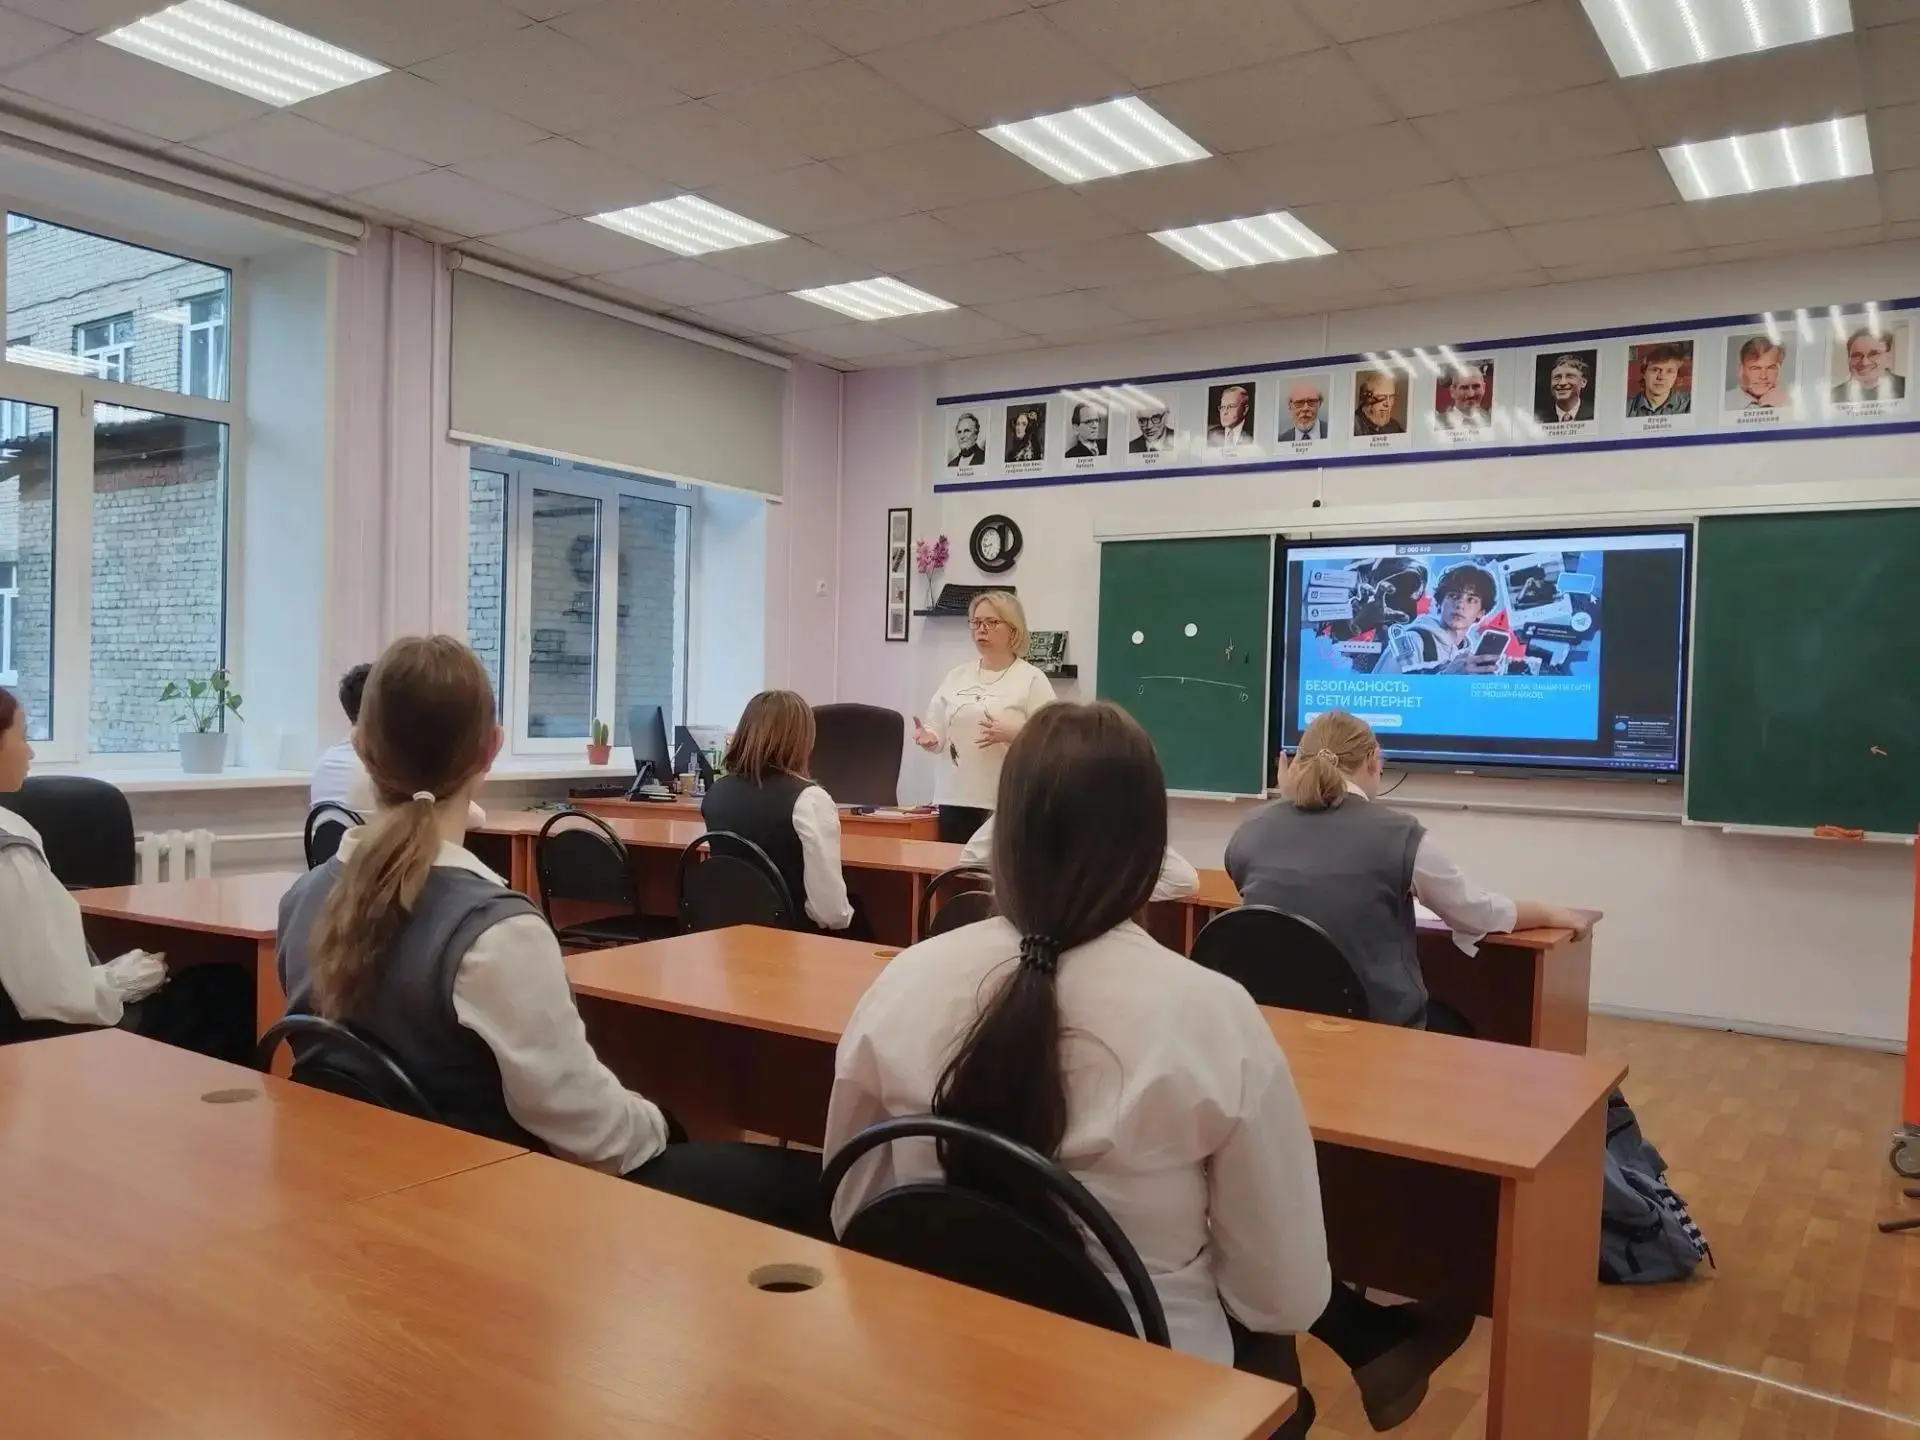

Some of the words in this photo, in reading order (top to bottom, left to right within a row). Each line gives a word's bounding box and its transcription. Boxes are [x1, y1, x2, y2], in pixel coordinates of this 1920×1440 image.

[1305, 679, 1409, 692] БЕЗОПАСНОСТЬ
[1305, 695, 1313, 705] В
[1316, 695, 1351, 706] СЕТИ
[1353, 695, 1423, 708] ИНТЕРНЕТ
